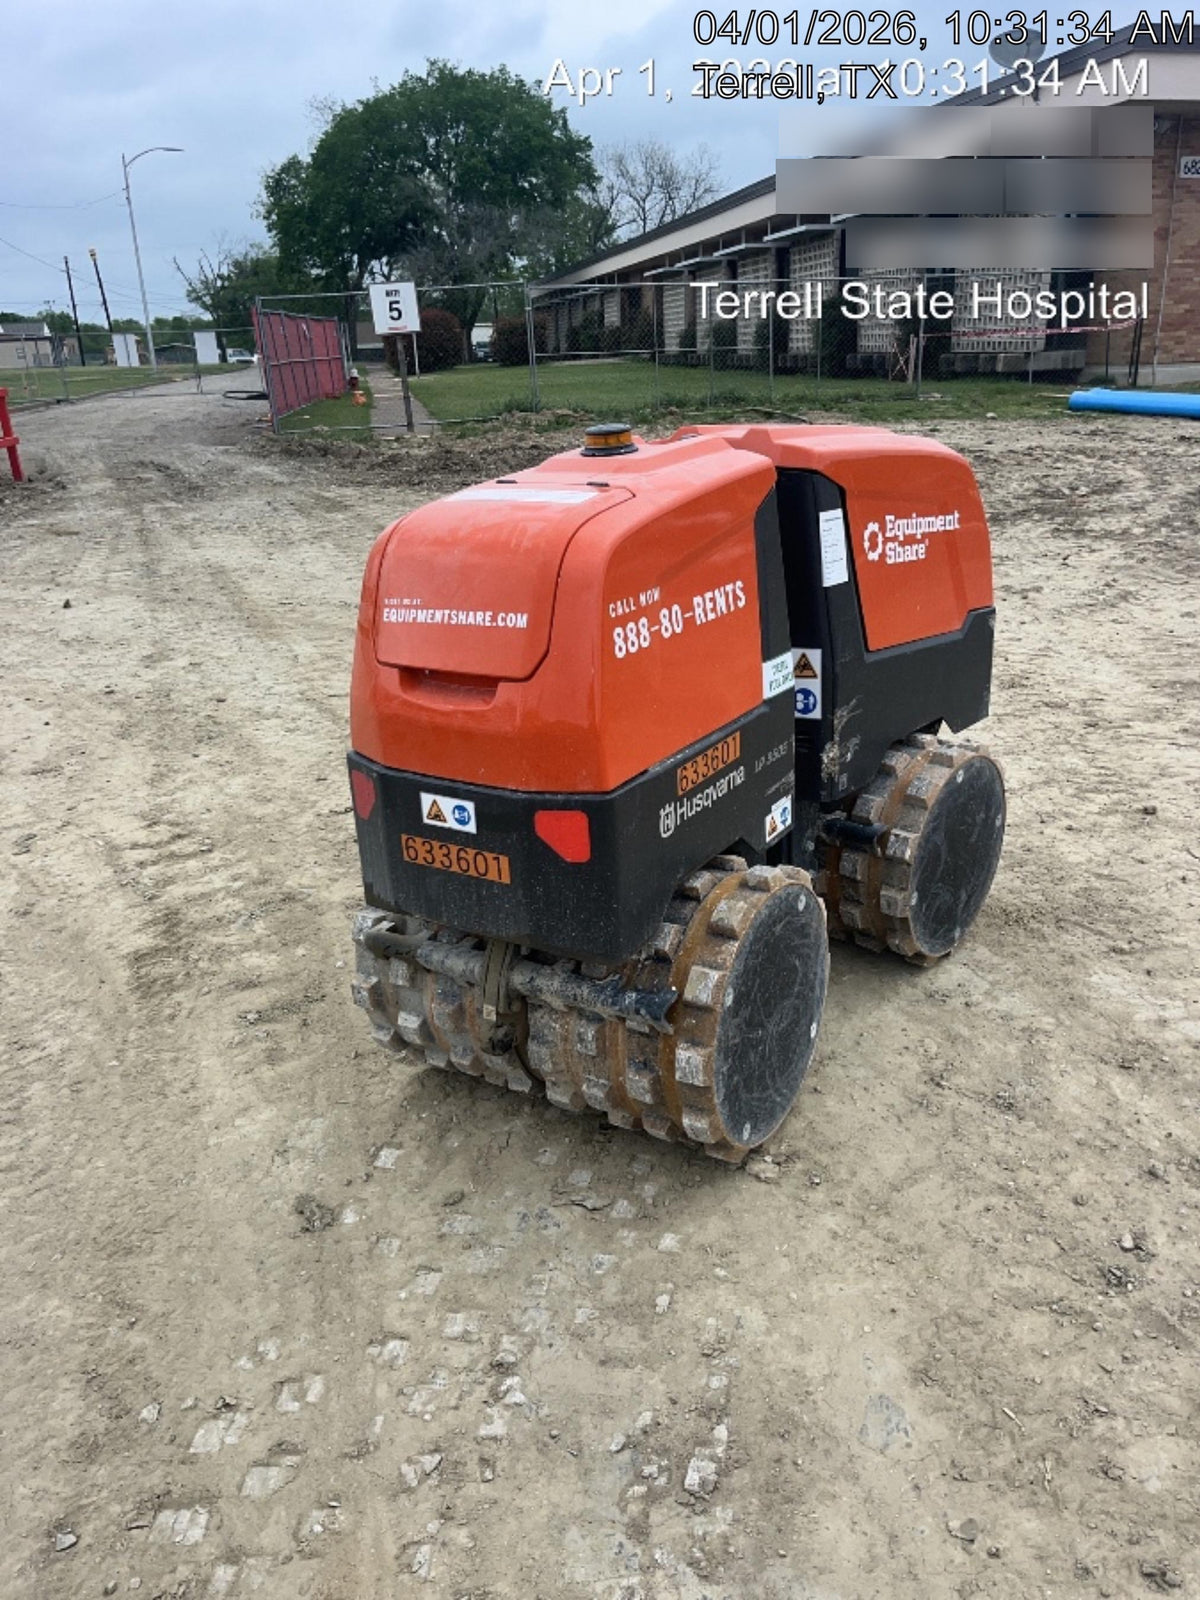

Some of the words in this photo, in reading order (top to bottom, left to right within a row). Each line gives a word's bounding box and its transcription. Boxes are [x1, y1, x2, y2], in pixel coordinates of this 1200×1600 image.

[388, 300, 402, 321] 5
[885, 510, 960, 541] Equipment
[885, 541, 926, 565] Share
[383, 607, 529, 629] EQUIPMENTSHARE.COM
[609, 597, 637, 618] CALL
[639, 586, 661, 607] NOW
[613, 580, 747, 659] 888-80-RENTS
[680, 736, 738, 793] 633601
[677, 765, 745, 826] Husqvarna
[405, 837, 502, 881] 633601
